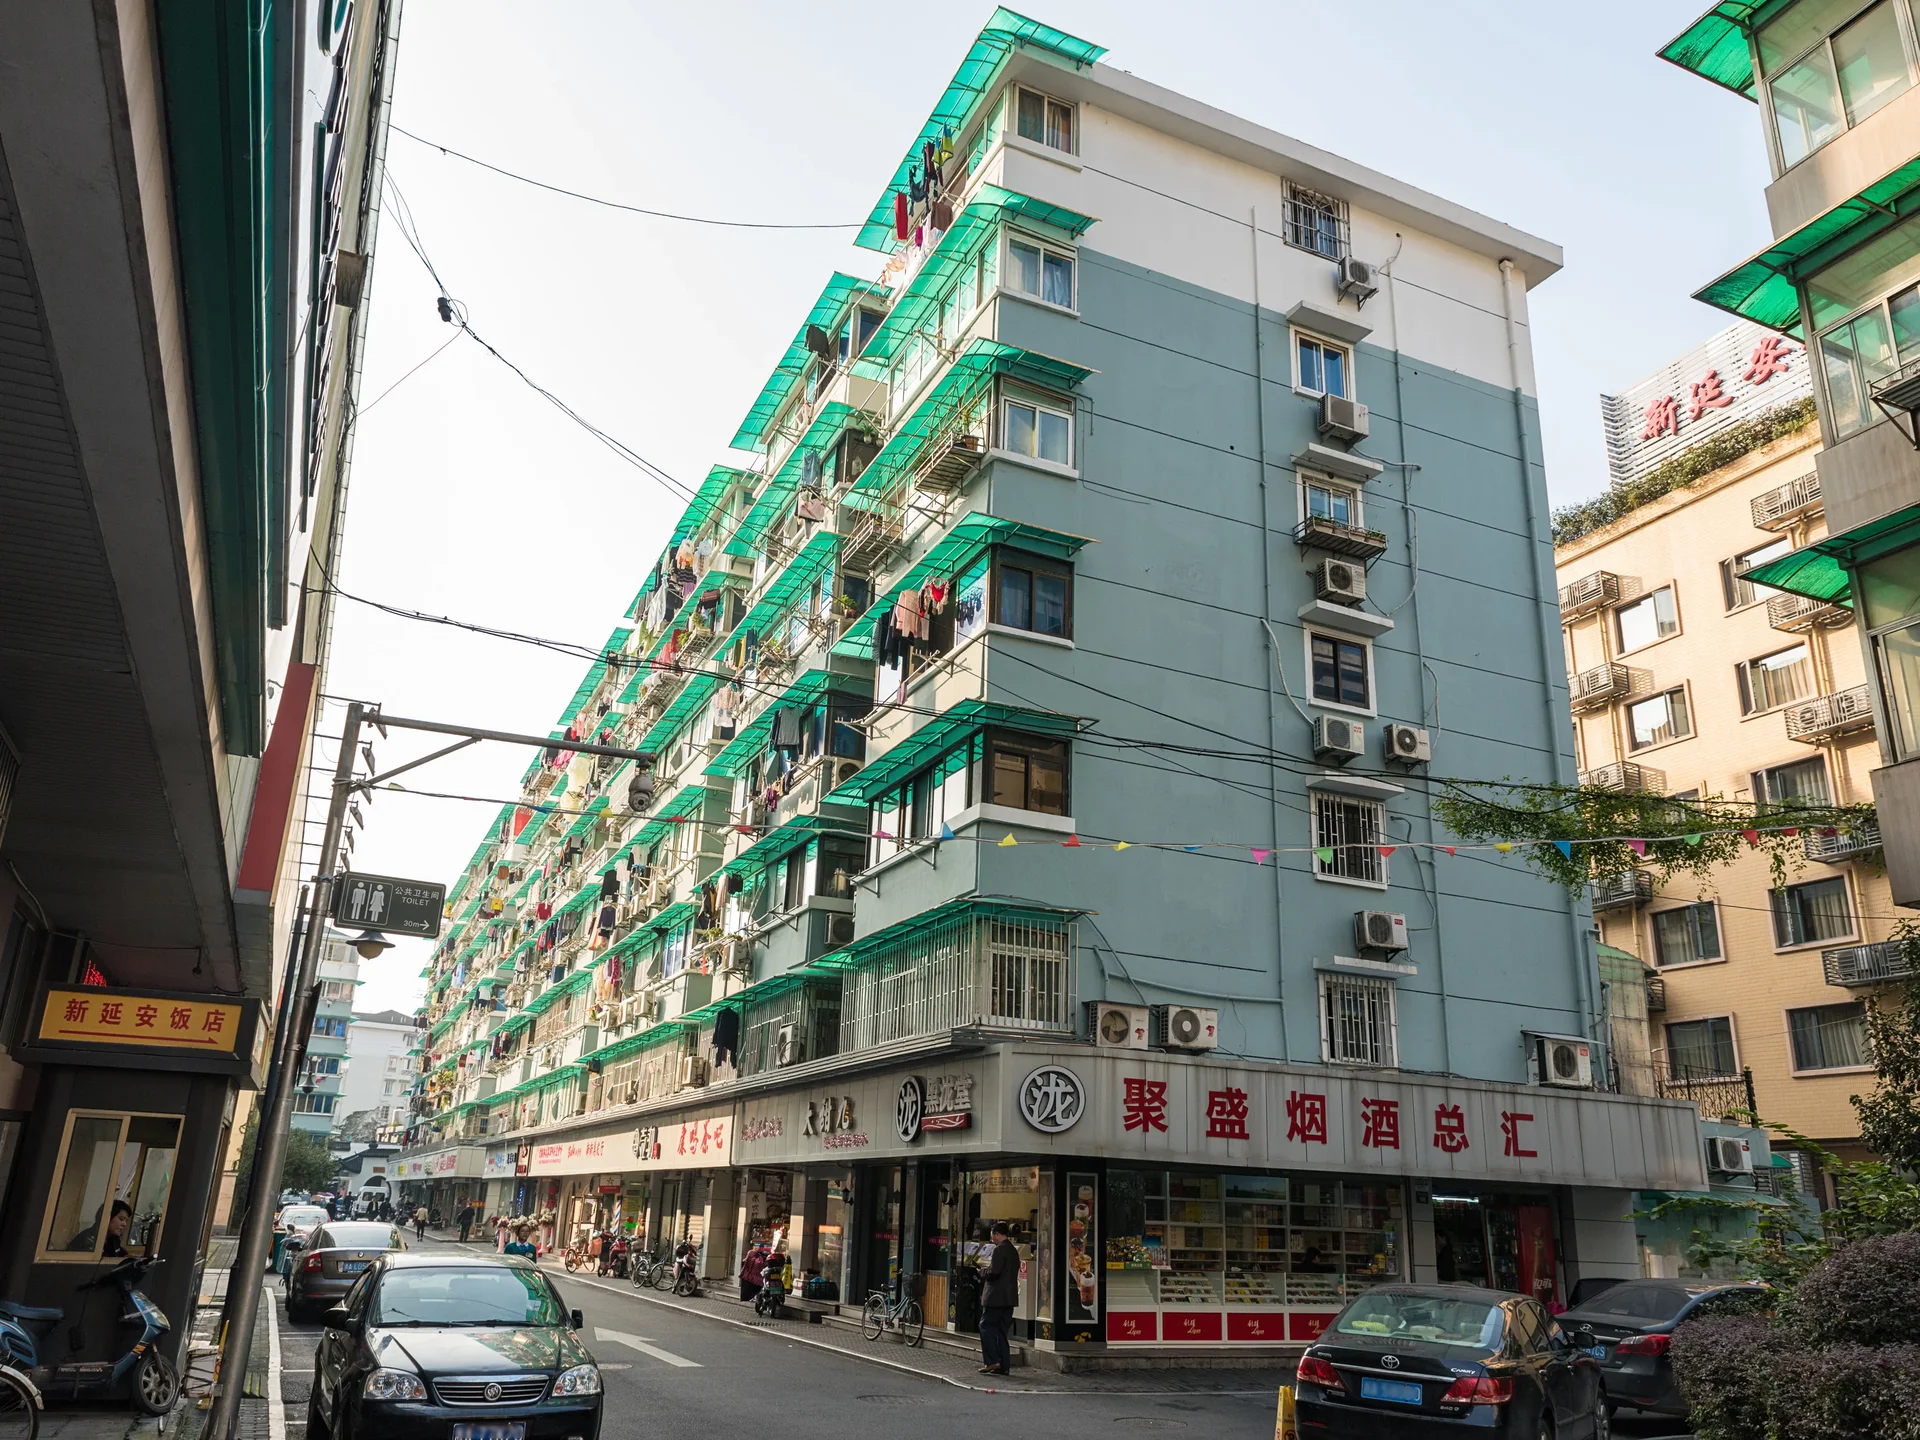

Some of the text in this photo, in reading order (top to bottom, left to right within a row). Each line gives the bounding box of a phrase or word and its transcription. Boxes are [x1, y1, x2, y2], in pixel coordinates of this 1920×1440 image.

[1641, 337, 1806, 440] 新延安
[395, 886, 440, 900] 公共卫生间
[402, 896, 430, 906] TOILET
[403, 920, 420, 928] 30m
[64, 998, 226, 1033] 新延安饭店
[924, 1073, 973, 1114] 黑泷堂
[1122, 1077, 1538, 1158] 聚盛烟酒总汇
